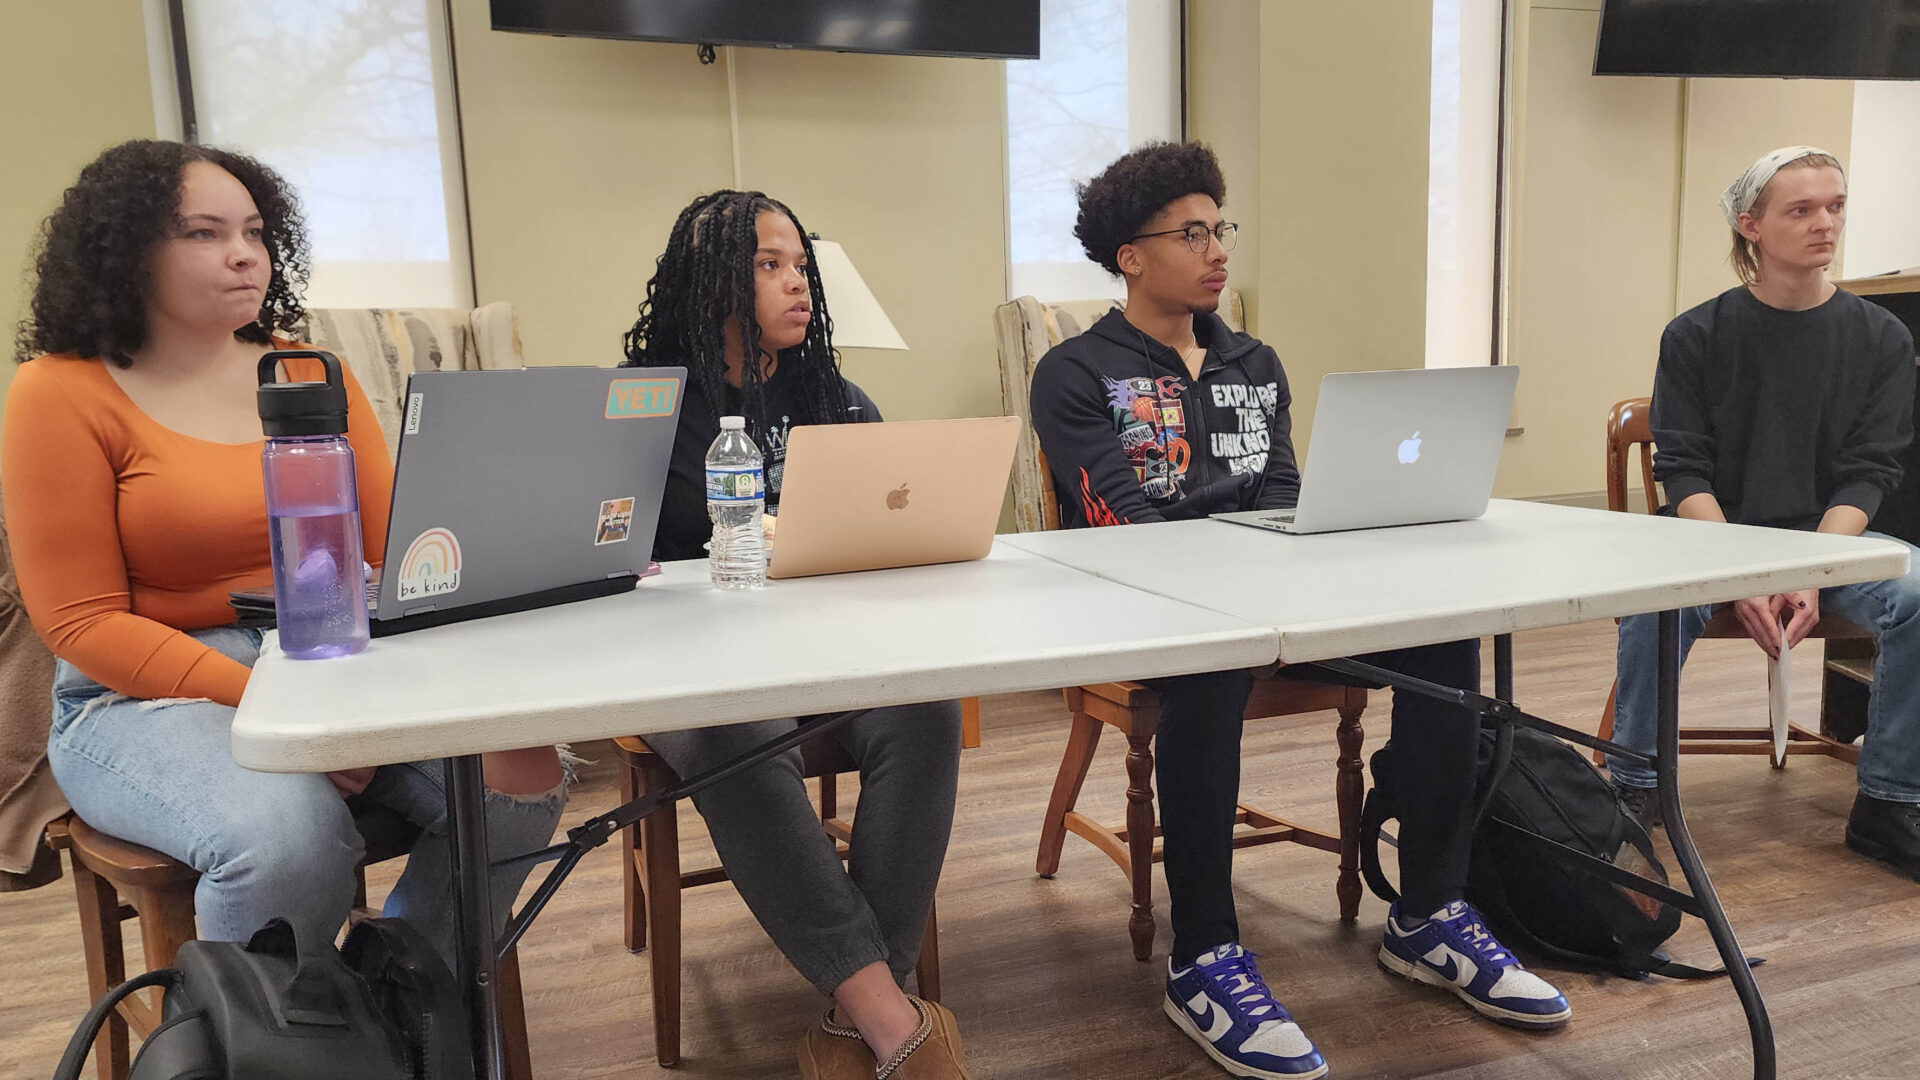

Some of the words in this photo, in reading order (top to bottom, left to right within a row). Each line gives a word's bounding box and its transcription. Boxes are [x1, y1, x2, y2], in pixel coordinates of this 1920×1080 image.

[615, 385, 672, 410] YETI
[1137, 380, 1152, 391] 23
[1210, 382, 1278, 409] EXPLORE
[408, 396, 420, 431] Lenovo
[1235, 407, 1268, 433] THE
[1158, 463, 1168, 474] 23
[401, 582, 417, 598] be
[424, 572, 457, 594] kind
